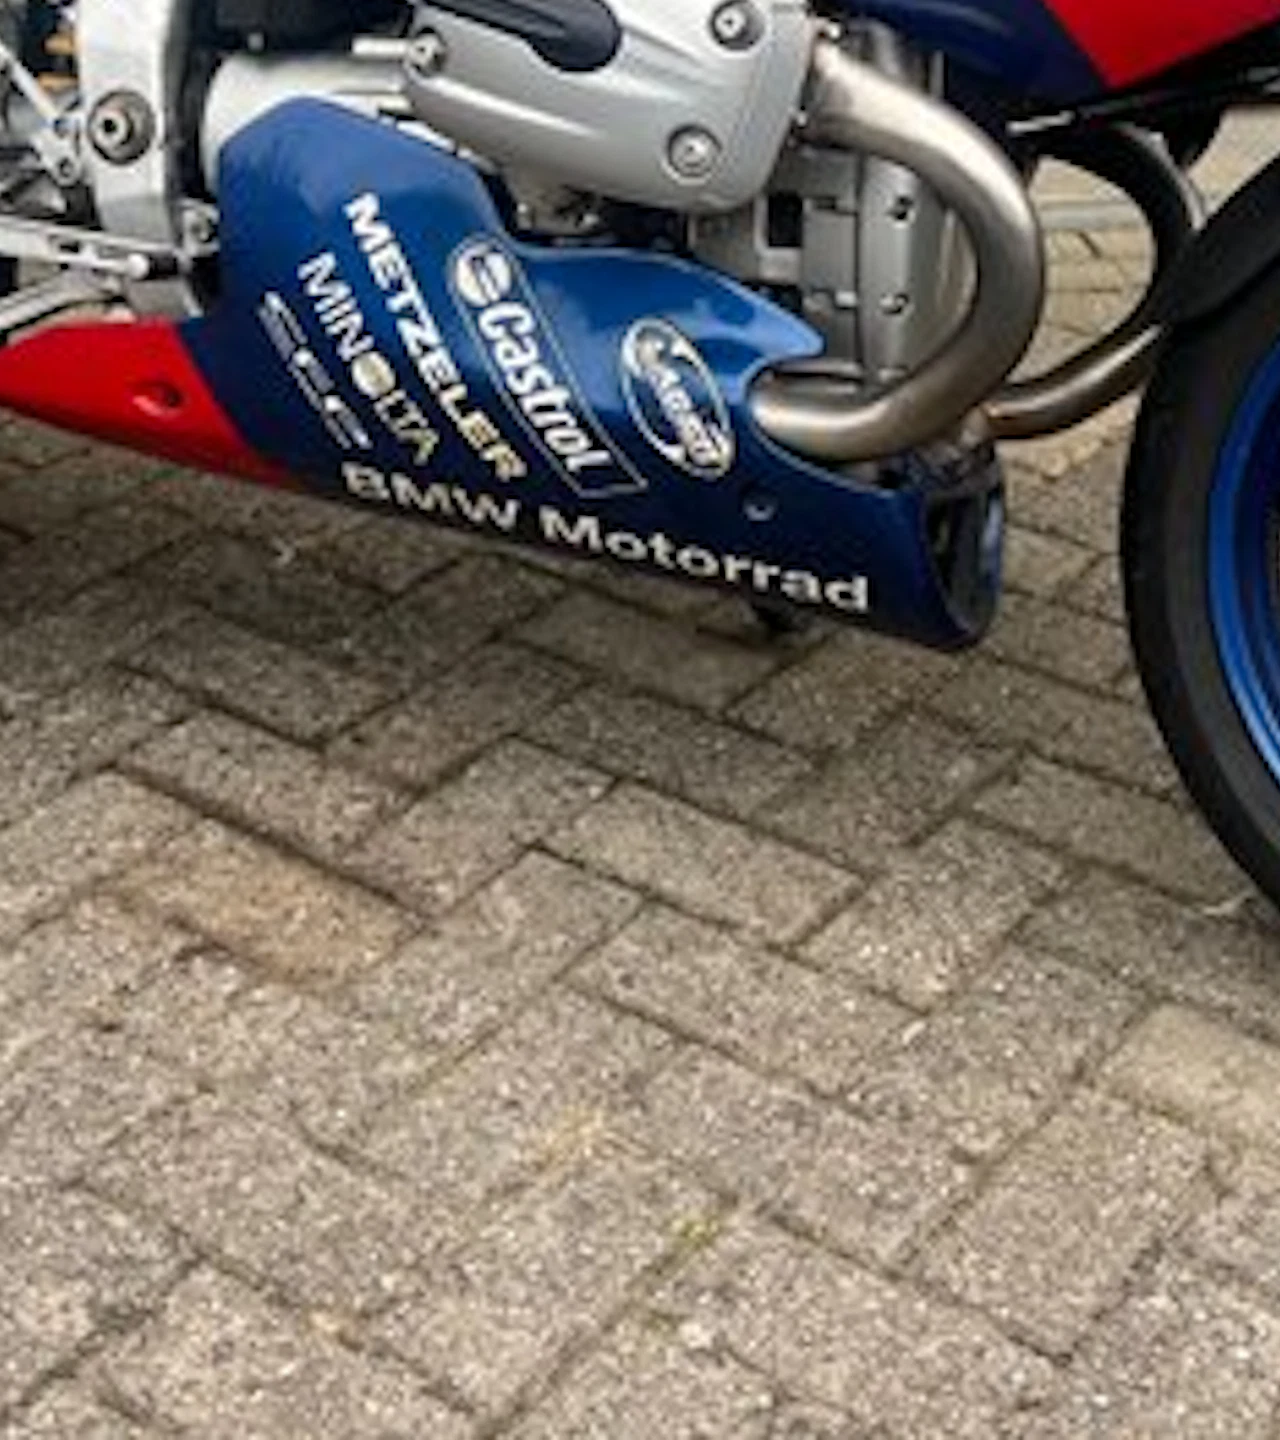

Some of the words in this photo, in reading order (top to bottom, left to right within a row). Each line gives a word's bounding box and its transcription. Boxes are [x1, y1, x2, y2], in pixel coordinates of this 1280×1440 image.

[296, 251, 439, 465] MINOLTA
[342, 192, 527, 481] METZELER
[478, 301, 611, 474] Castrol
[341, 461, 519, 531] BMW
[538, 505, 870, 612] Motorrad
